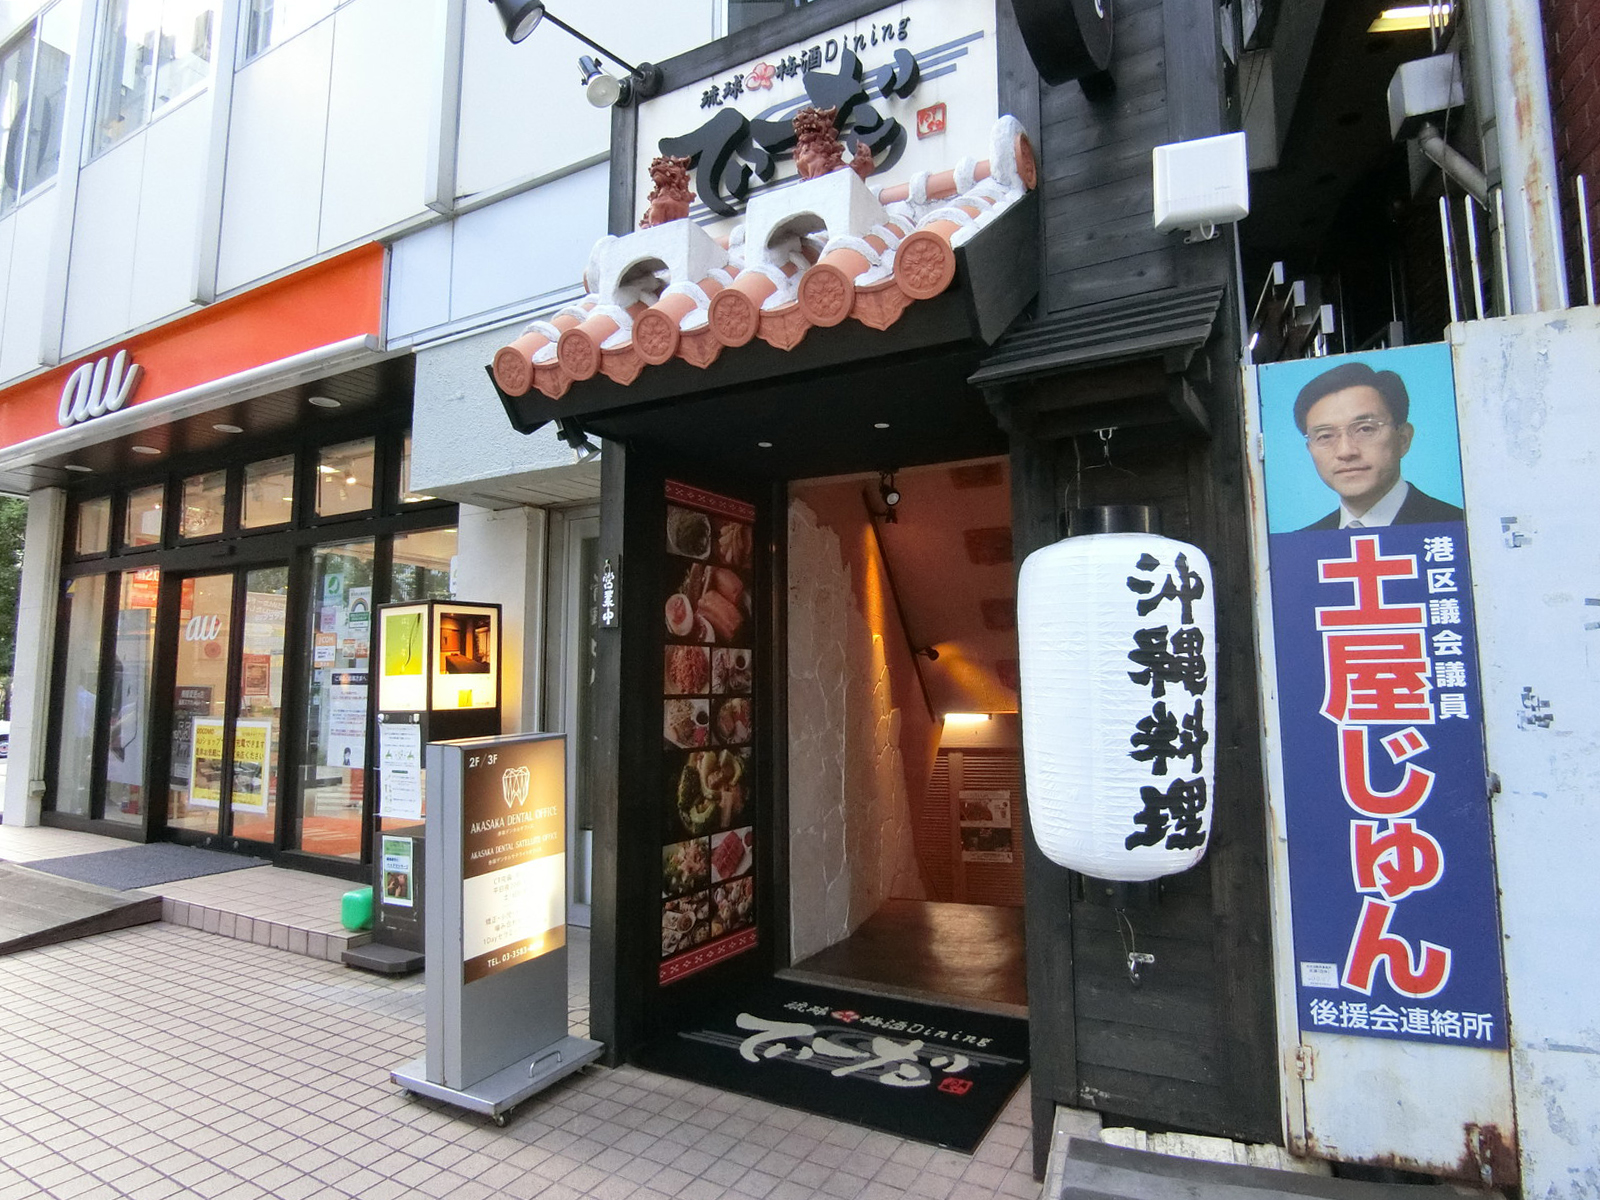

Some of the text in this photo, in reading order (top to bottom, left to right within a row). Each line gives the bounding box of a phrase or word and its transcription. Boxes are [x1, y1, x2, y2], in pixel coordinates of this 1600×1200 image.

[700, 74, 744, 109] 琉球
[58, 349, 144, 428] au
[602, 571, 615, 626] 営業中
[185, 615, 222, 642] au
[1423, 535, 1470, 720] 港区議会議員
[1125, 552, 1208, 852] 沖縄料理
[1314, 534, 1452, 999] 土屋じゅん
[470, 806, 558, 834] AKASAKA DENTAL OFFICE
[470, 847, 495, 860] AKASAKA
[495, 843, 514, 855] DENTAL
[487, 957, 501, 968] TEL.
[1310, 998, 1494, 1042] 後援会連絡所
